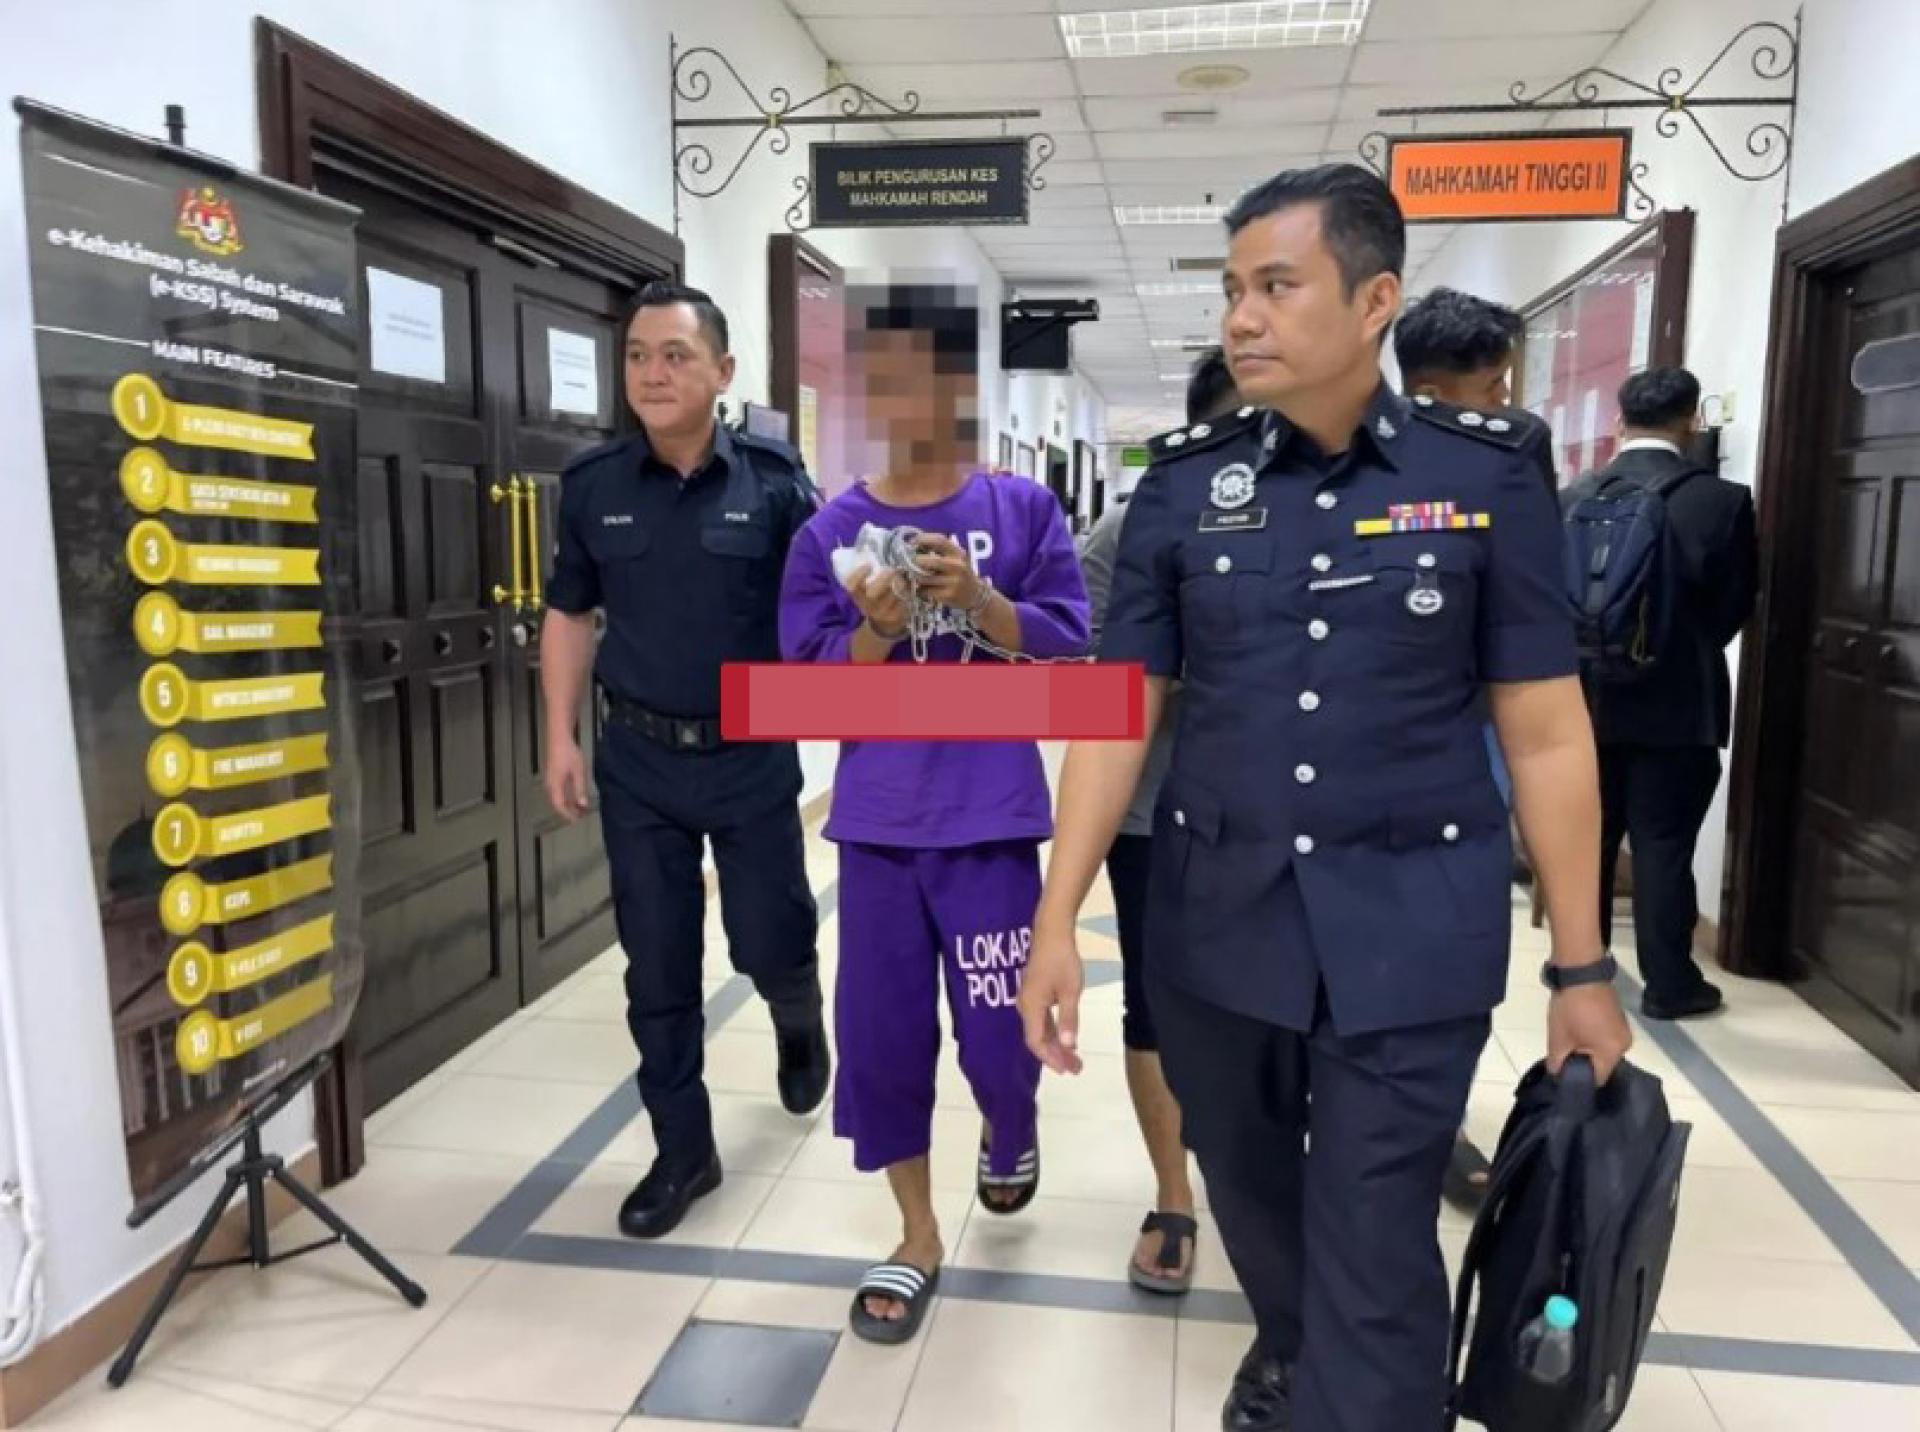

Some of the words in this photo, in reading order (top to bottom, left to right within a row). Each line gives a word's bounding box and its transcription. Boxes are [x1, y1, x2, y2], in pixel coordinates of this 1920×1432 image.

[837, 170, 871, 186] BILIK
[875, 168, 967, 184] PENGURUSAN
[970, 168, 998, 182] KES
[1407, 165, 1518, 195] MAHKAMAH
[1524, 162, 1590, 193] TINGGI
[849, 190, 928, 207] MAHKAMAH
[930, 189, 988, 205] RENDAH
[152, 340, 199, 363] MAIN
[136, 394, 146, 421] 1
[141, 466, 153, 494] 2
[145, 537, 159, 567] 3
[152, 609, 166, 637] 4
[158, 680, 171, 708] 5
[164, 751, 177, 779] 6
[169, 819, 182, 848] 7
[178, 890, 191, 917] 8
[956, 927, 1031, 969] LOKAP
[184, 959, 198, 986] 9
[192, 1027, 209, 1057] 10
